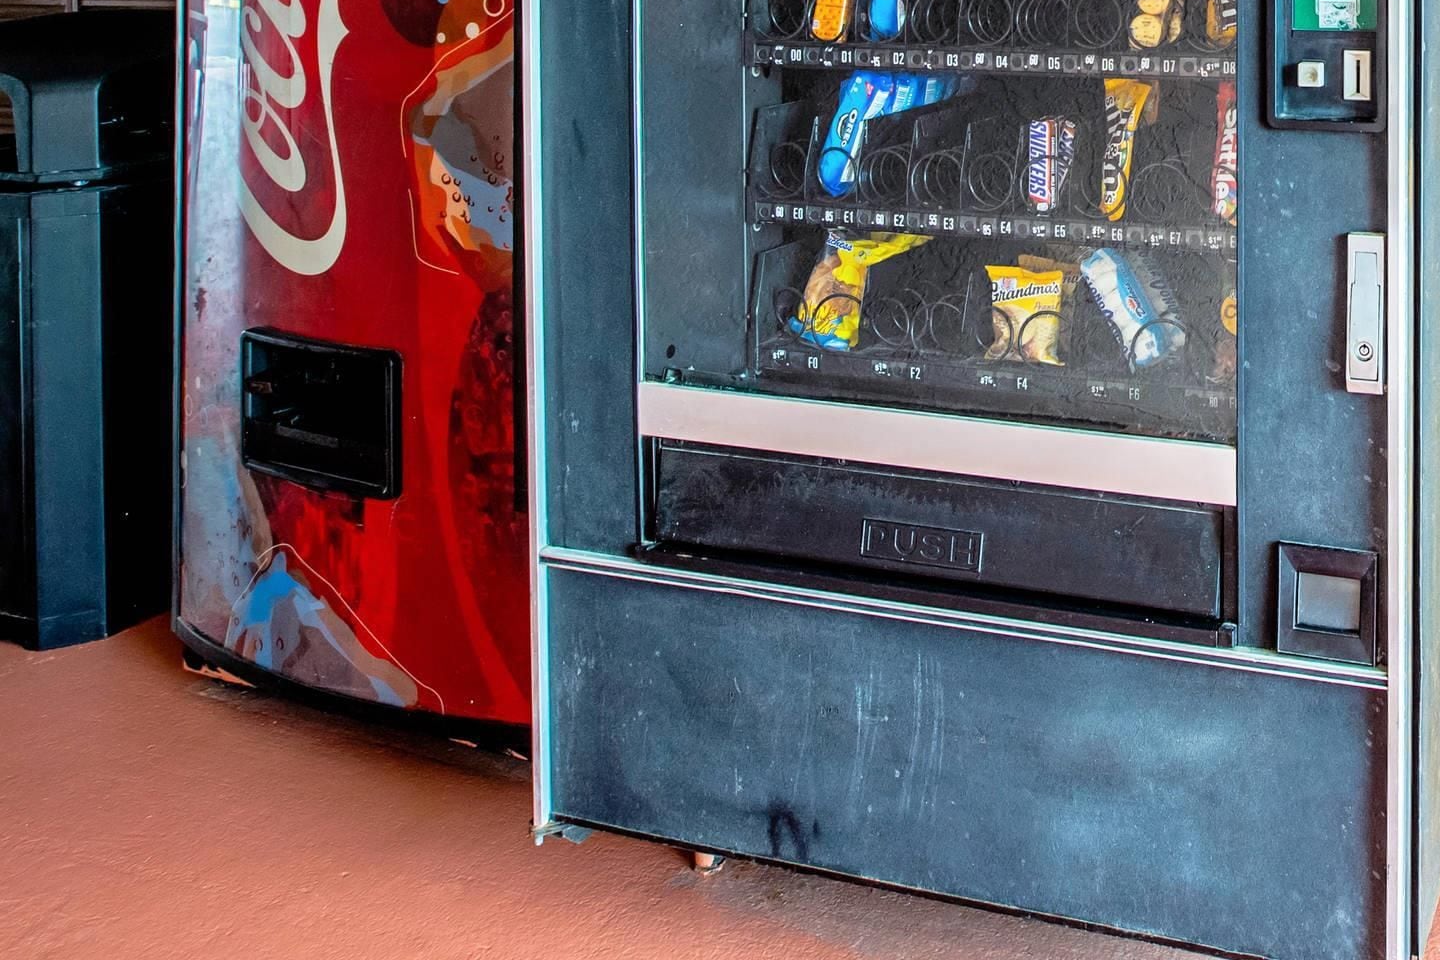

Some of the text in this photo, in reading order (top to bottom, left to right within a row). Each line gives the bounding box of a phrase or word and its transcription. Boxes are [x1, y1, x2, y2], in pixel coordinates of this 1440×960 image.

[840, 108, 858, 148] OREO
[1029, 119, 1048, 198] SNICKERS
[843, 210, 854, 224] E1
[893, 214, 905, 227] E2
[943, 217, 954, 230] E3
[1000, 221, 1011, 234] E4
[1111, 228, 1123, 241] E6
[826, 236, 853, 251] uchess
[1169, 231, 1181, 245] E7
[991, 281, 1061, 303] Grandma's
[910, 366, 921, 380] F2
[1016, 377, 1028, 390] F4
[1128, 388, 1140, 401] F6
[866, 524, 976, 566] PUSH
